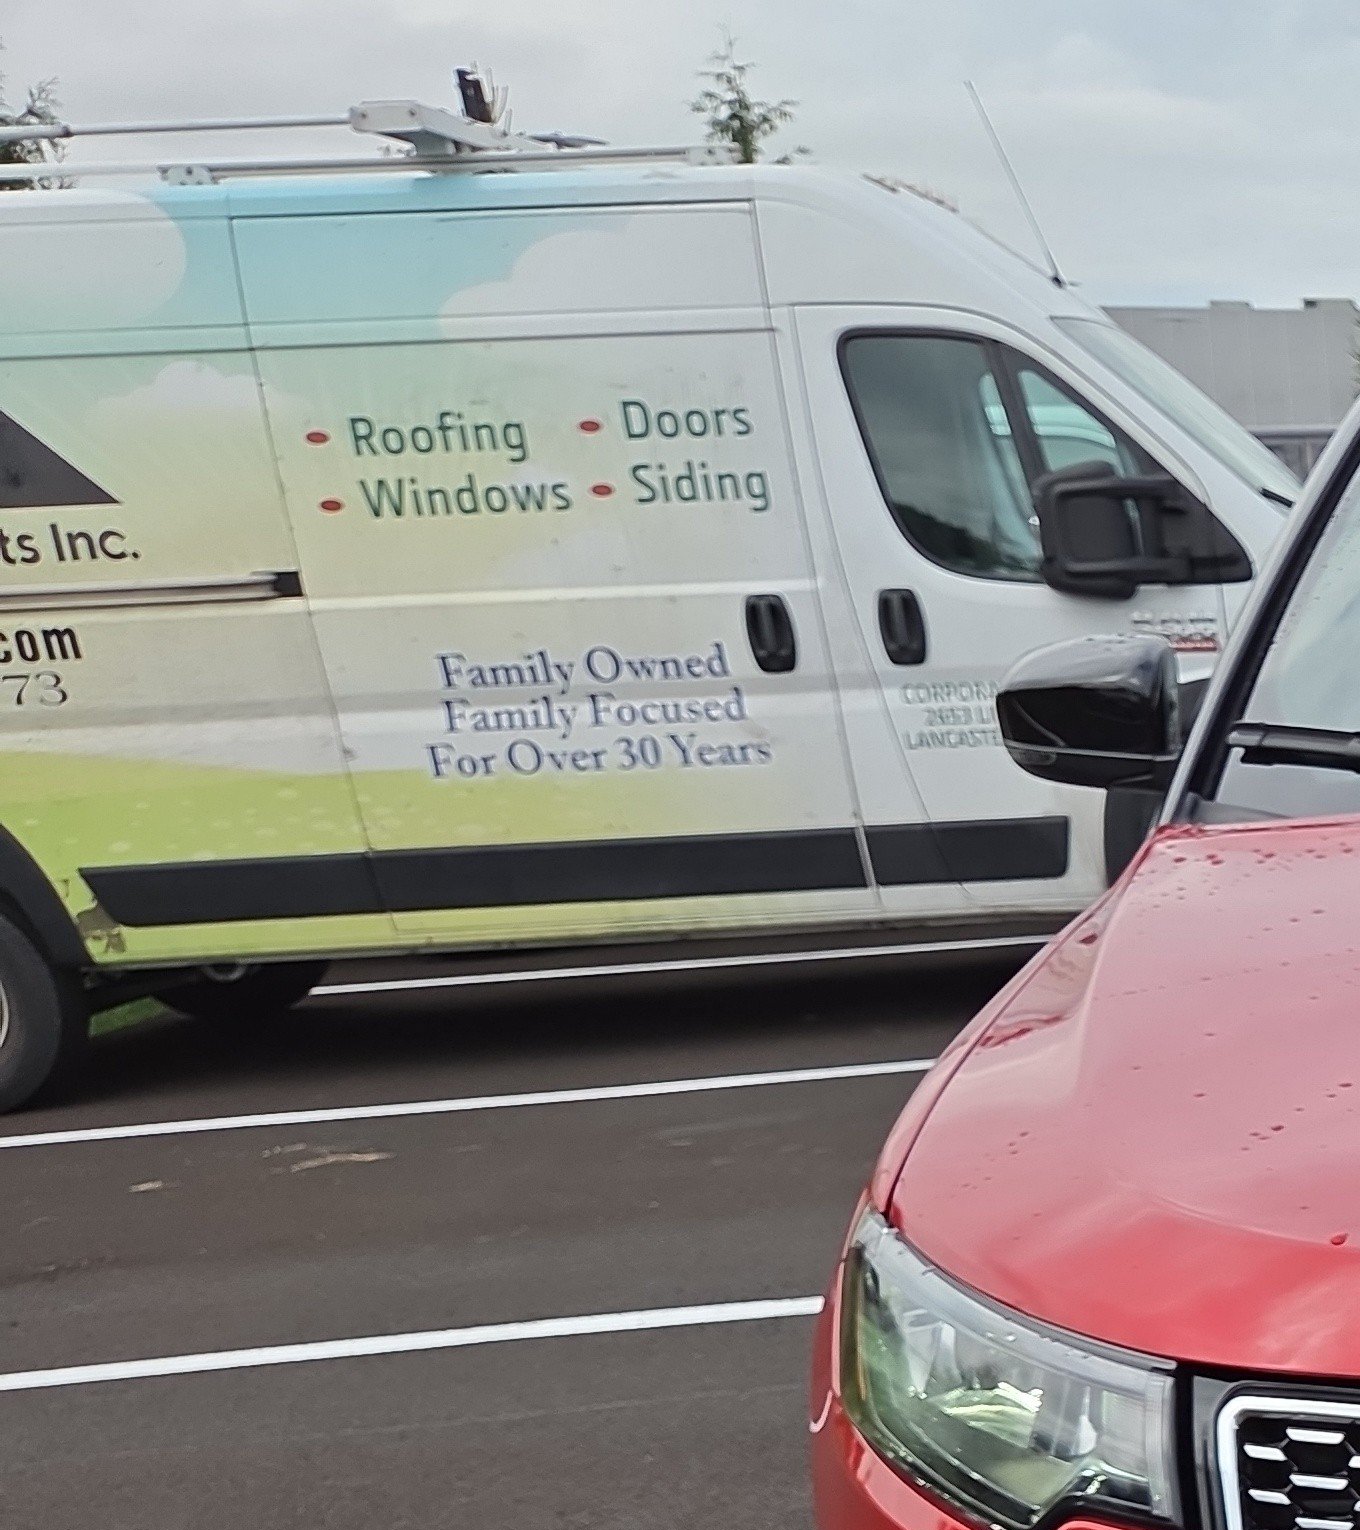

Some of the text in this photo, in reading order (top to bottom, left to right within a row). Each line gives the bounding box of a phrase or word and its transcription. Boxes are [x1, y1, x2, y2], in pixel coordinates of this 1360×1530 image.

[349, 411, 528, 463] Roofing
[620, 399, 752, 440] Doors
[358, 473, 573, 519] Windows
[630, 460, 770, 512] Siding
[50, 523, 141, 561] Inc.
[2, 671, 68, 706] 73
[435, 641, 731, 695] Family Owned
[442, 686, 749, 739] Family Focused
[426, 732, 773, 778] For Over 30 Years
